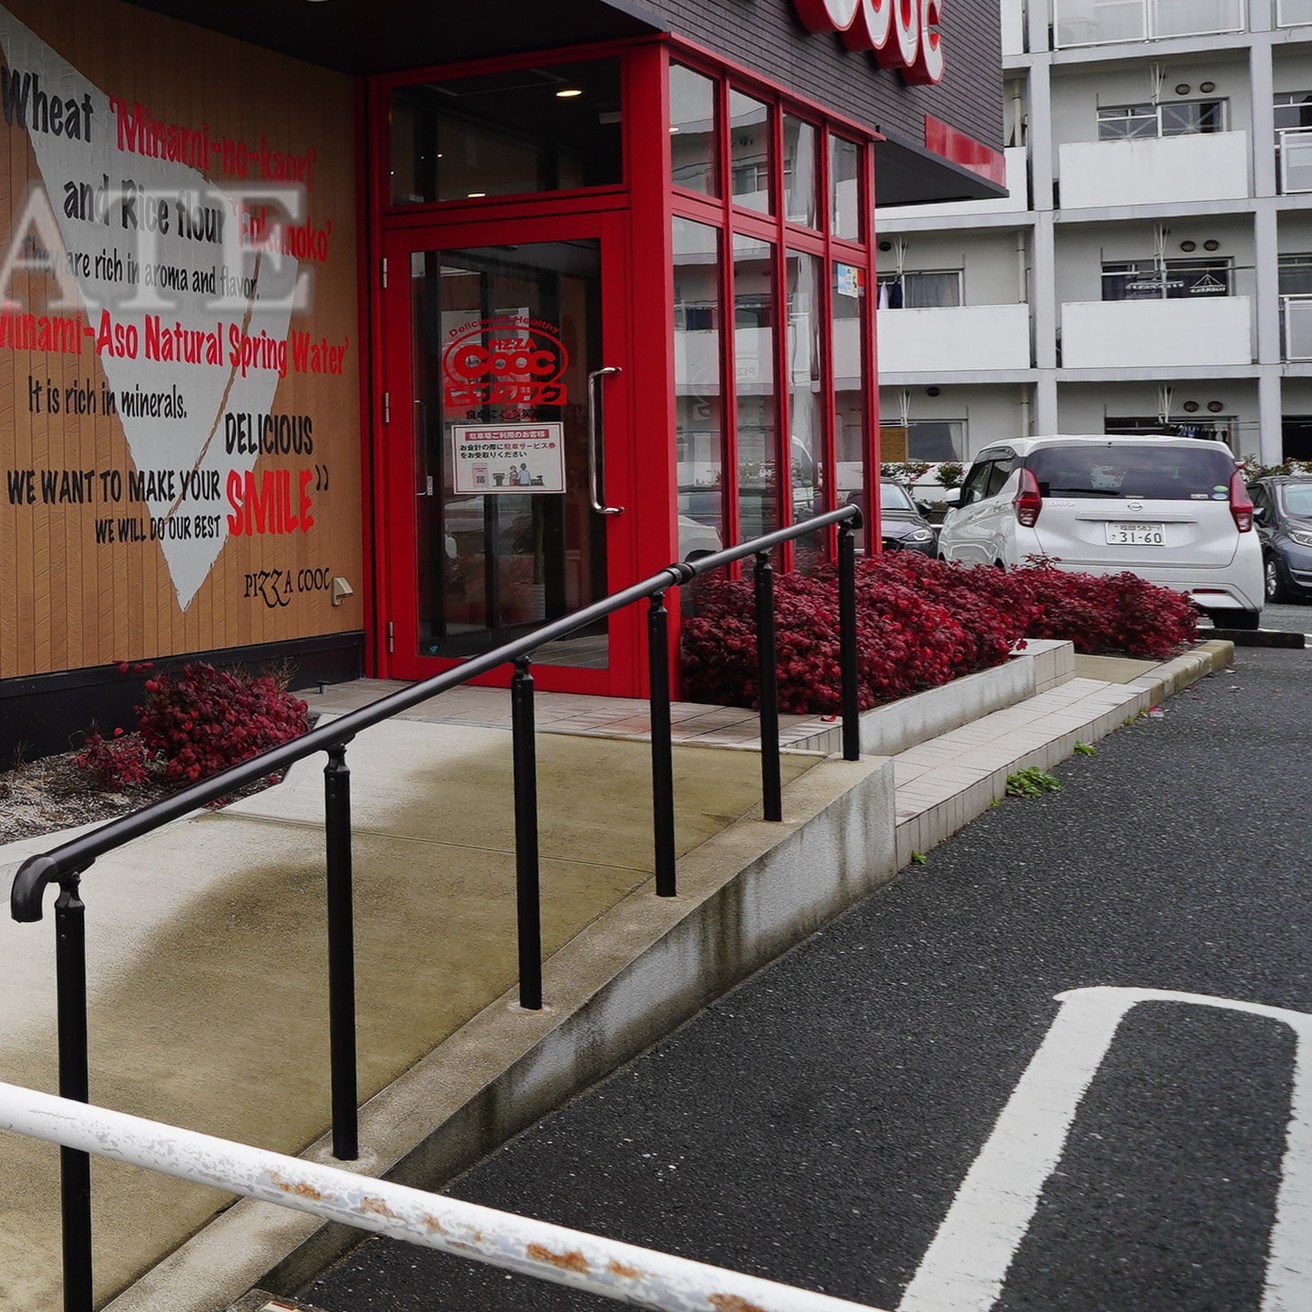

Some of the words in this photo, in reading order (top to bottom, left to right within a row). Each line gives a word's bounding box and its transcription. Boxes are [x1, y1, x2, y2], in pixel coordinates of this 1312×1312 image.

[63, 173, 110, 227] and
[121, 179, 170, 235] Rice
[175, 190, 225, 245] flour
[64, 249, 90, 279] are
[94, 248, 123, 282] rich
[127, 252, 140, 285] in
[144, 263, 189, 291] aroma
[192, 265, 217, 296] and
[145, 314, 223, 367] Natural
[229, 323, 288, 379] Spring
[28, 375, 43, 413] It
[46, 385, 60, 415] is
[65, 383, 96, 416] rich
[101, 387, 117, 417] in
[121, 384, 188, 420] minerals.
[224, 412, 314, 456] DELICIOUS
[7, 470, 37, 505] WE
[41, 470, 95, 504] WANT
[99, 470, 122, 503] TO
[128, 470, 176, 503] MAKE
[179, 469, 222, 502] YOUR
[95, 517, 115, 543] WE
[117, 517, 147, 543] WILL
[150, 517, 165, 541] DO
[168, 516, 192, 540] OUR
[194, 515, 222, 539] BEST
[1120, 532, 1162, 544] 31-60
[243, 568, 294, 609] PIZZA
